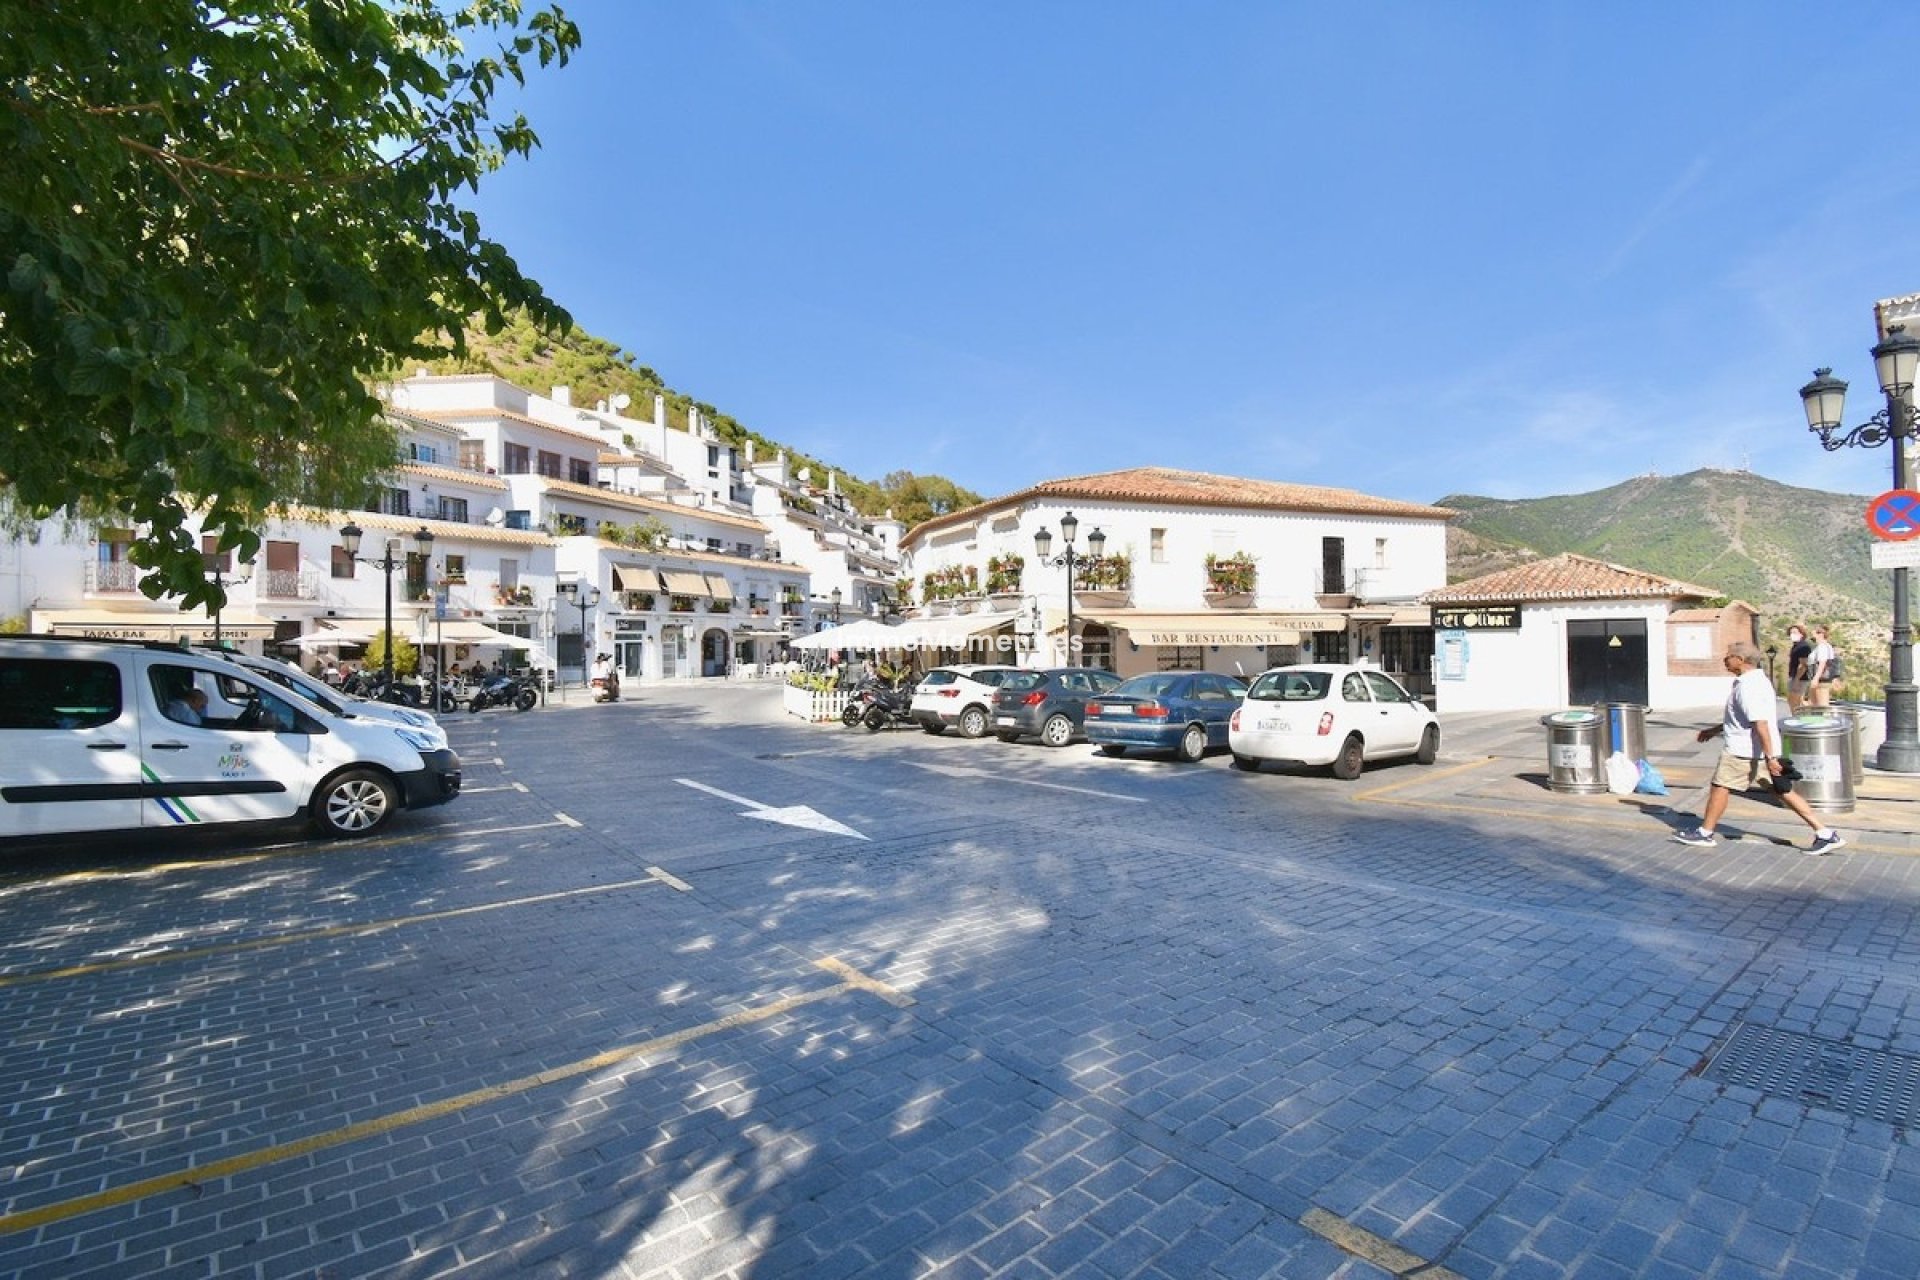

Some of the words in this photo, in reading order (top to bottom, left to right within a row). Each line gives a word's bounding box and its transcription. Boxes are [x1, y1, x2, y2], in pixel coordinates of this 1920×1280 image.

[84, 629, 118, 639] TAPAS
[122, 630, 146, 639] BAR
[1152, 633, 1178, 643] BAR
[1186, 633, 1282, 643] RESTAURANTE
